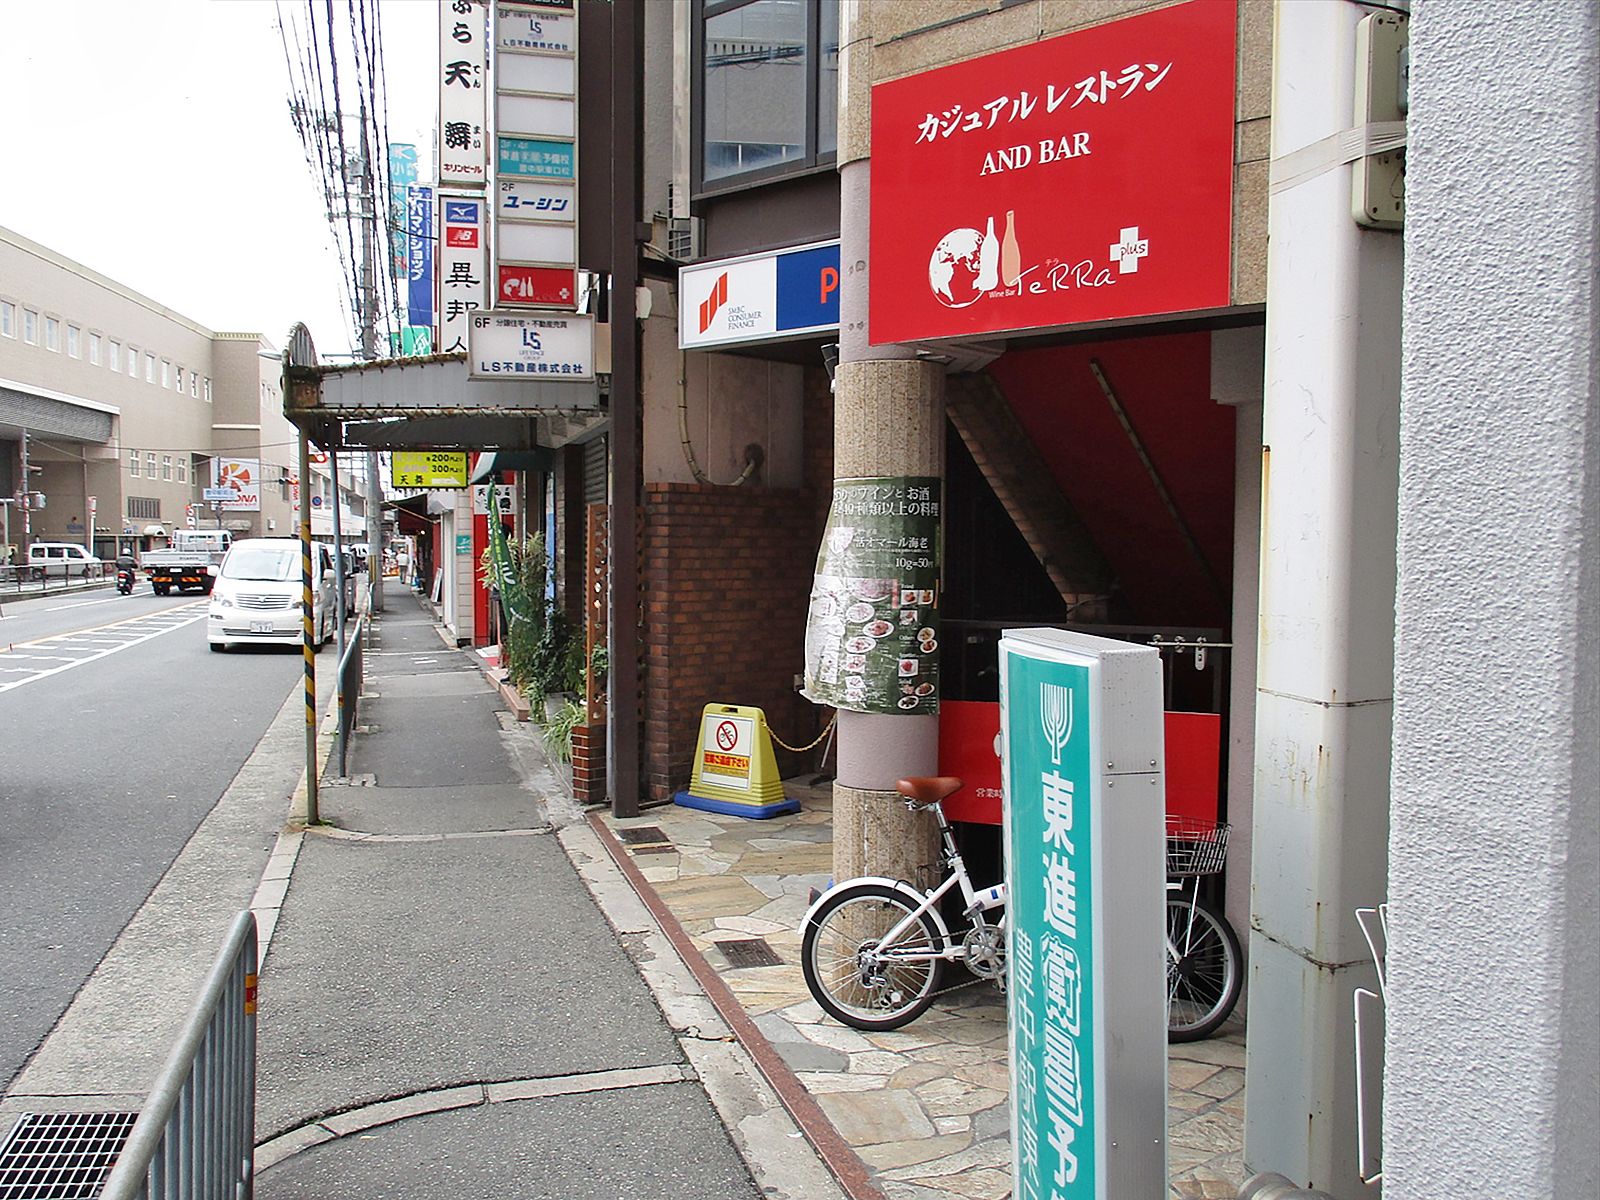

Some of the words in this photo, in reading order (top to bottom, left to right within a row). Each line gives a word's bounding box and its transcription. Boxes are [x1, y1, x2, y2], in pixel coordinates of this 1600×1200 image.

[915, 104, 1038, 145] カジュアル
[1046, 62, 1173, 114] レストラン
[979, 144, 1032, 176] AND
[1038, 131, 1092, 165] BAR
[443, 163, 482, 174] キリンビール
[501, 183, 515, 191] 2F
[503, 196, 568, 211] ユーシン
[1119, 243, 1146, 262] plus
[988, 291, 1005, 299] Wine
[1005, 289, 1016, 298] Bar
[445, 262, 480, 352] 異邦人
[728, 305, 746, 314] SMBC
[474, 318, 491, 328] 6F
[728, 310, 763, 323] CONSUMER
[728, 319, 755, 330] FINANCE
[522, 328, 541, 350] LS
[481, 362, 583, 374] LS不動産株式会社
[1040, 770, 1084, 1200] 東進衛星予
